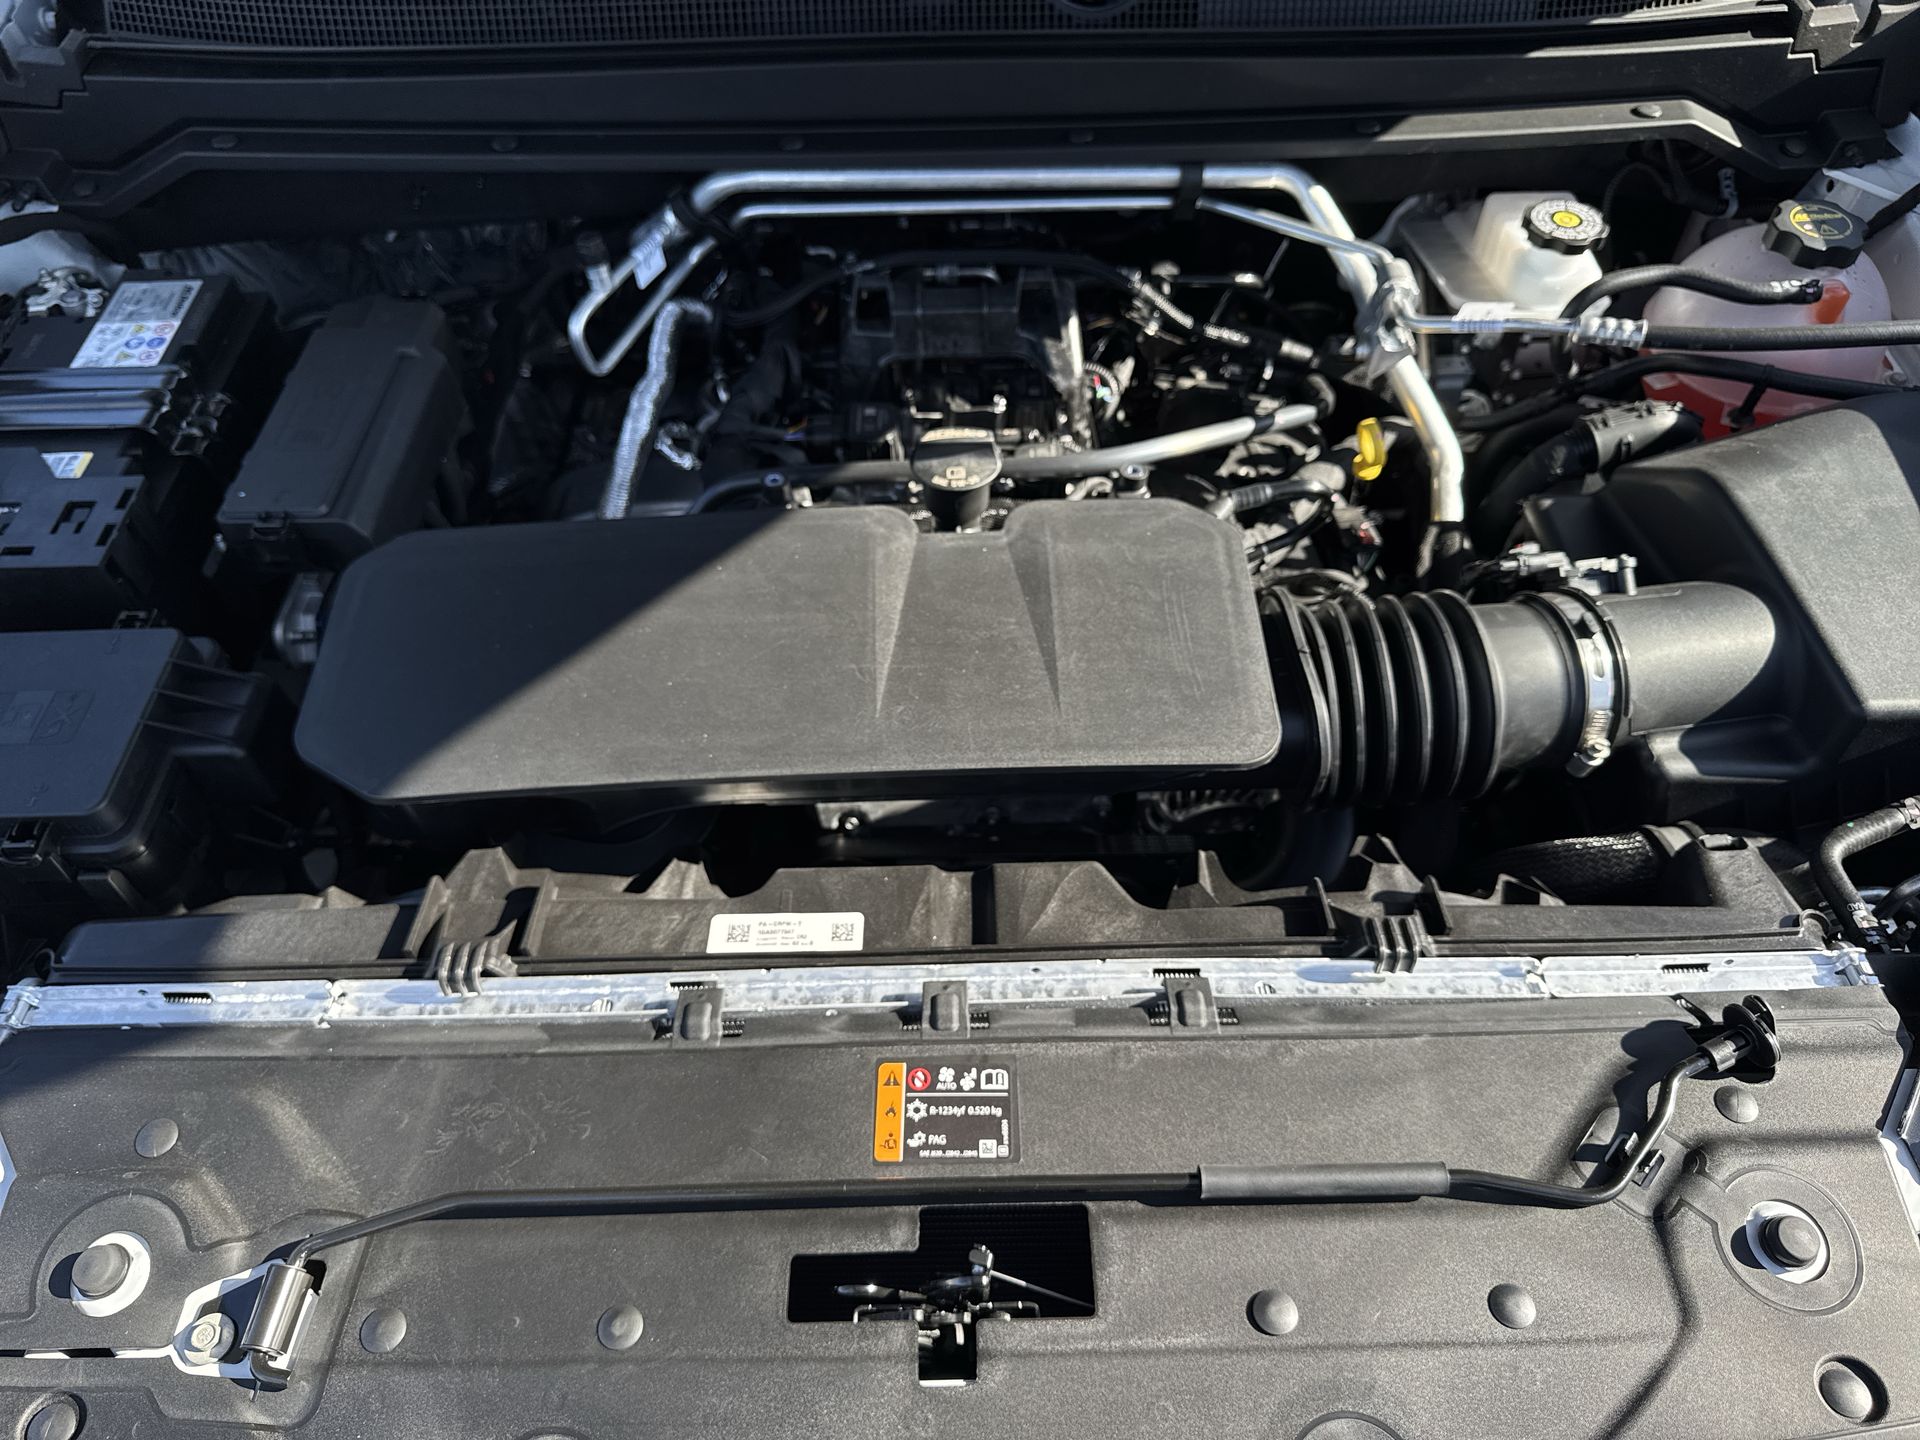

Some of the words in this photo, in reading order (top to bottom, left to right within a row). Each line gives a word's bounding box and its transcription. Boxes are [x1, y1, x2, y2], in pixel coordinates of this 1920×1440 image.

[936, 1082, 957, 1091] AUTO
[929, 1105, 966, 1117] R-1234yf
[967, 1105, 991, 1116] 0.520
[991, 1105, 1003, 1117] kg
[927, 1134, 947, 1146] PAG
